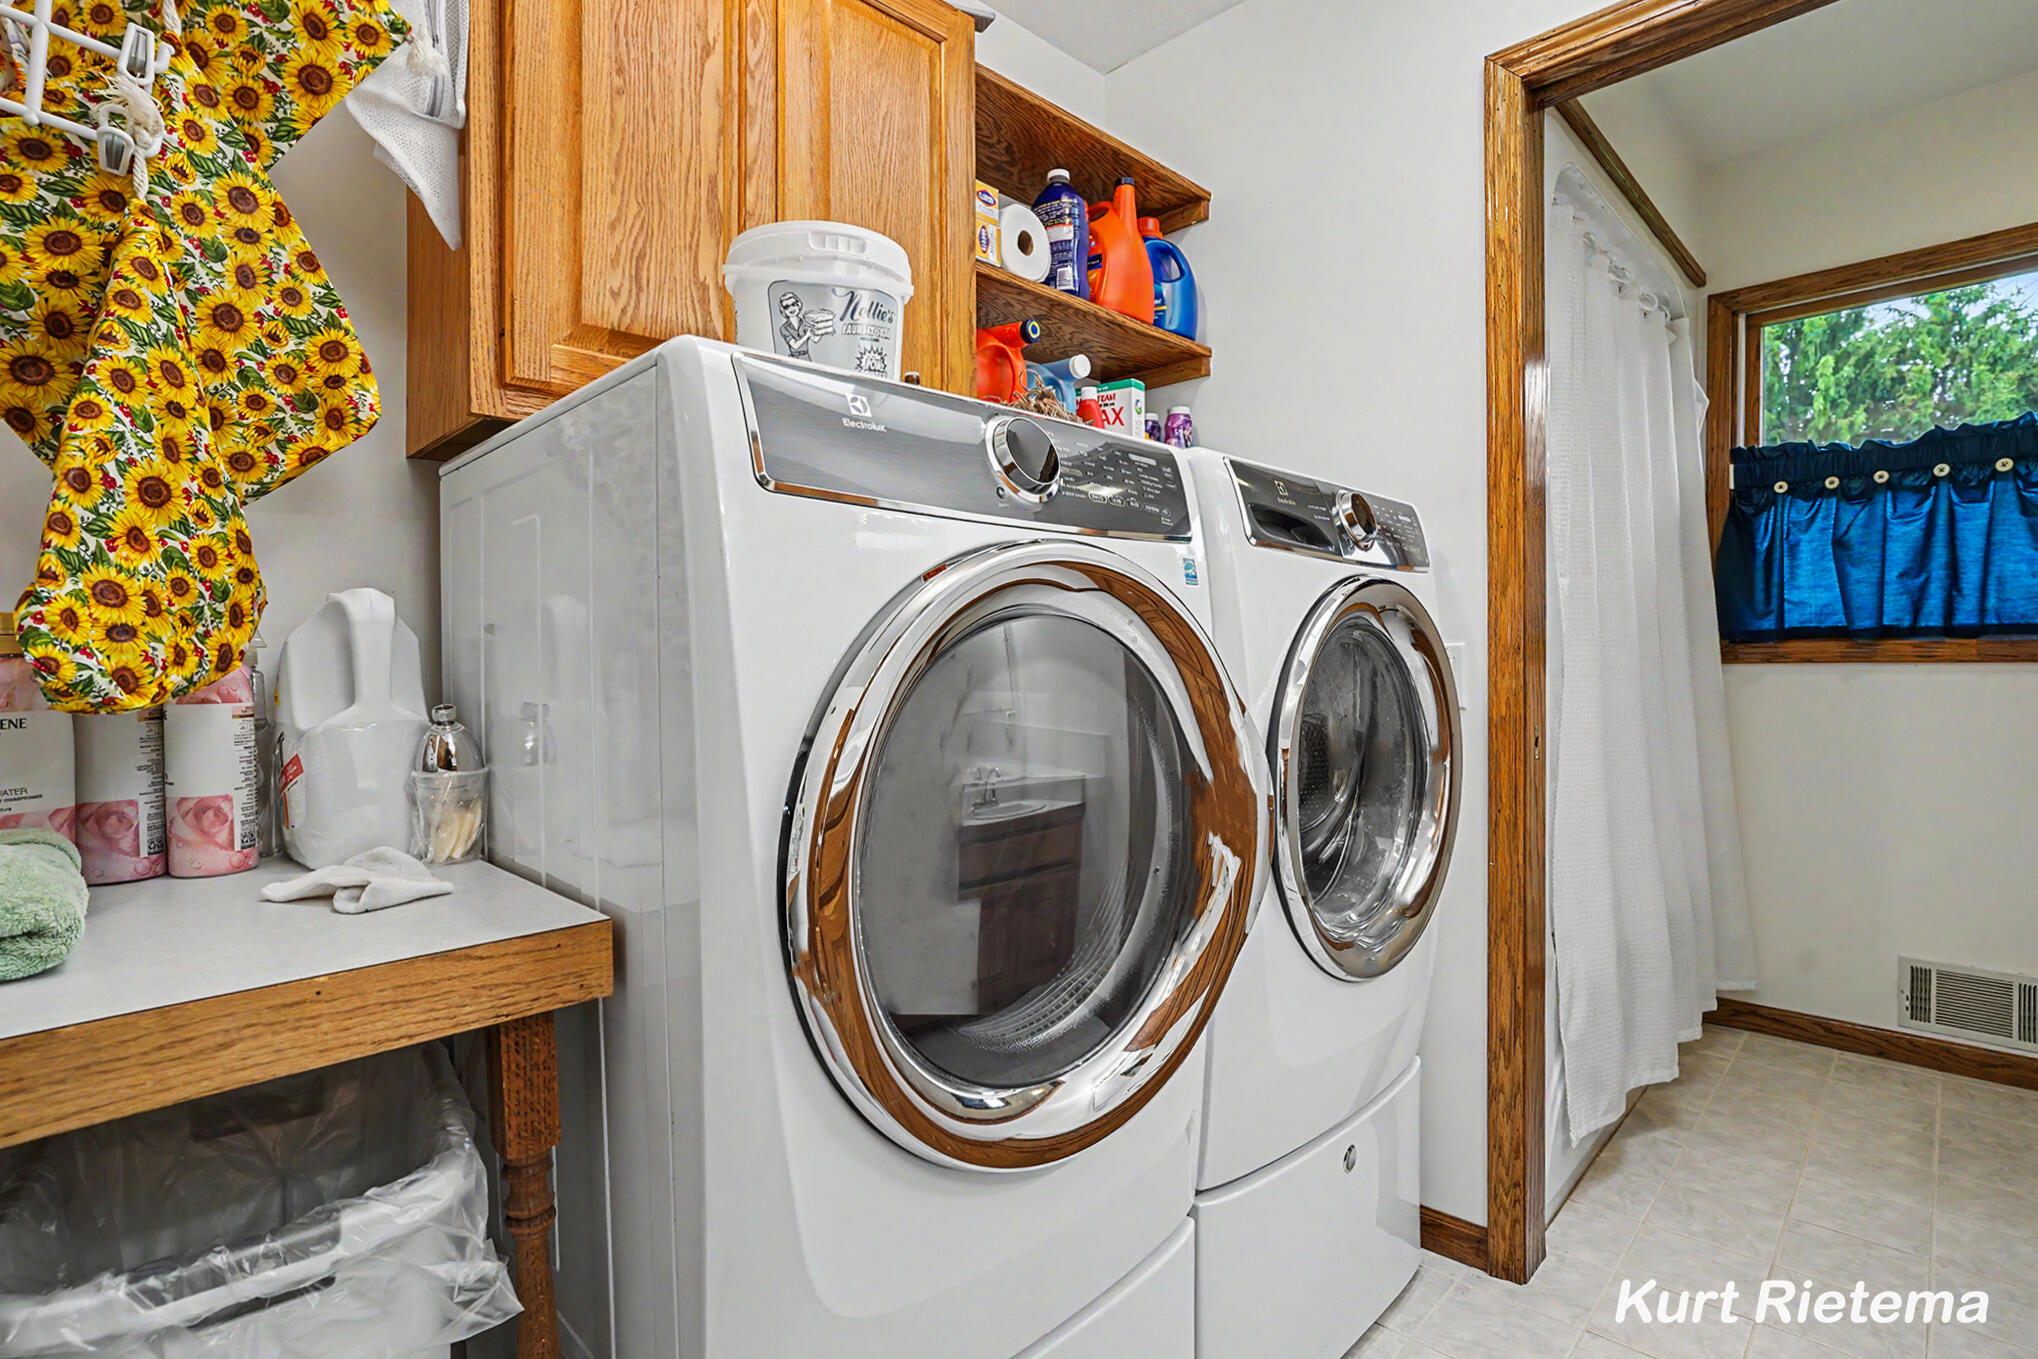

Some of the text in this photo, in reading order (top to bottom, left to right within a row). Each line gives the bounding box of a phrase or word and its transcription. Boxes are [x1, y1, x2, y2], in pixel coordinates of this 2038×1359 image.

[832, 288, 894, 323] Nellie's
[842, 417, 887, 433] Electrolux
[0, 787, 28, 797] ATER
